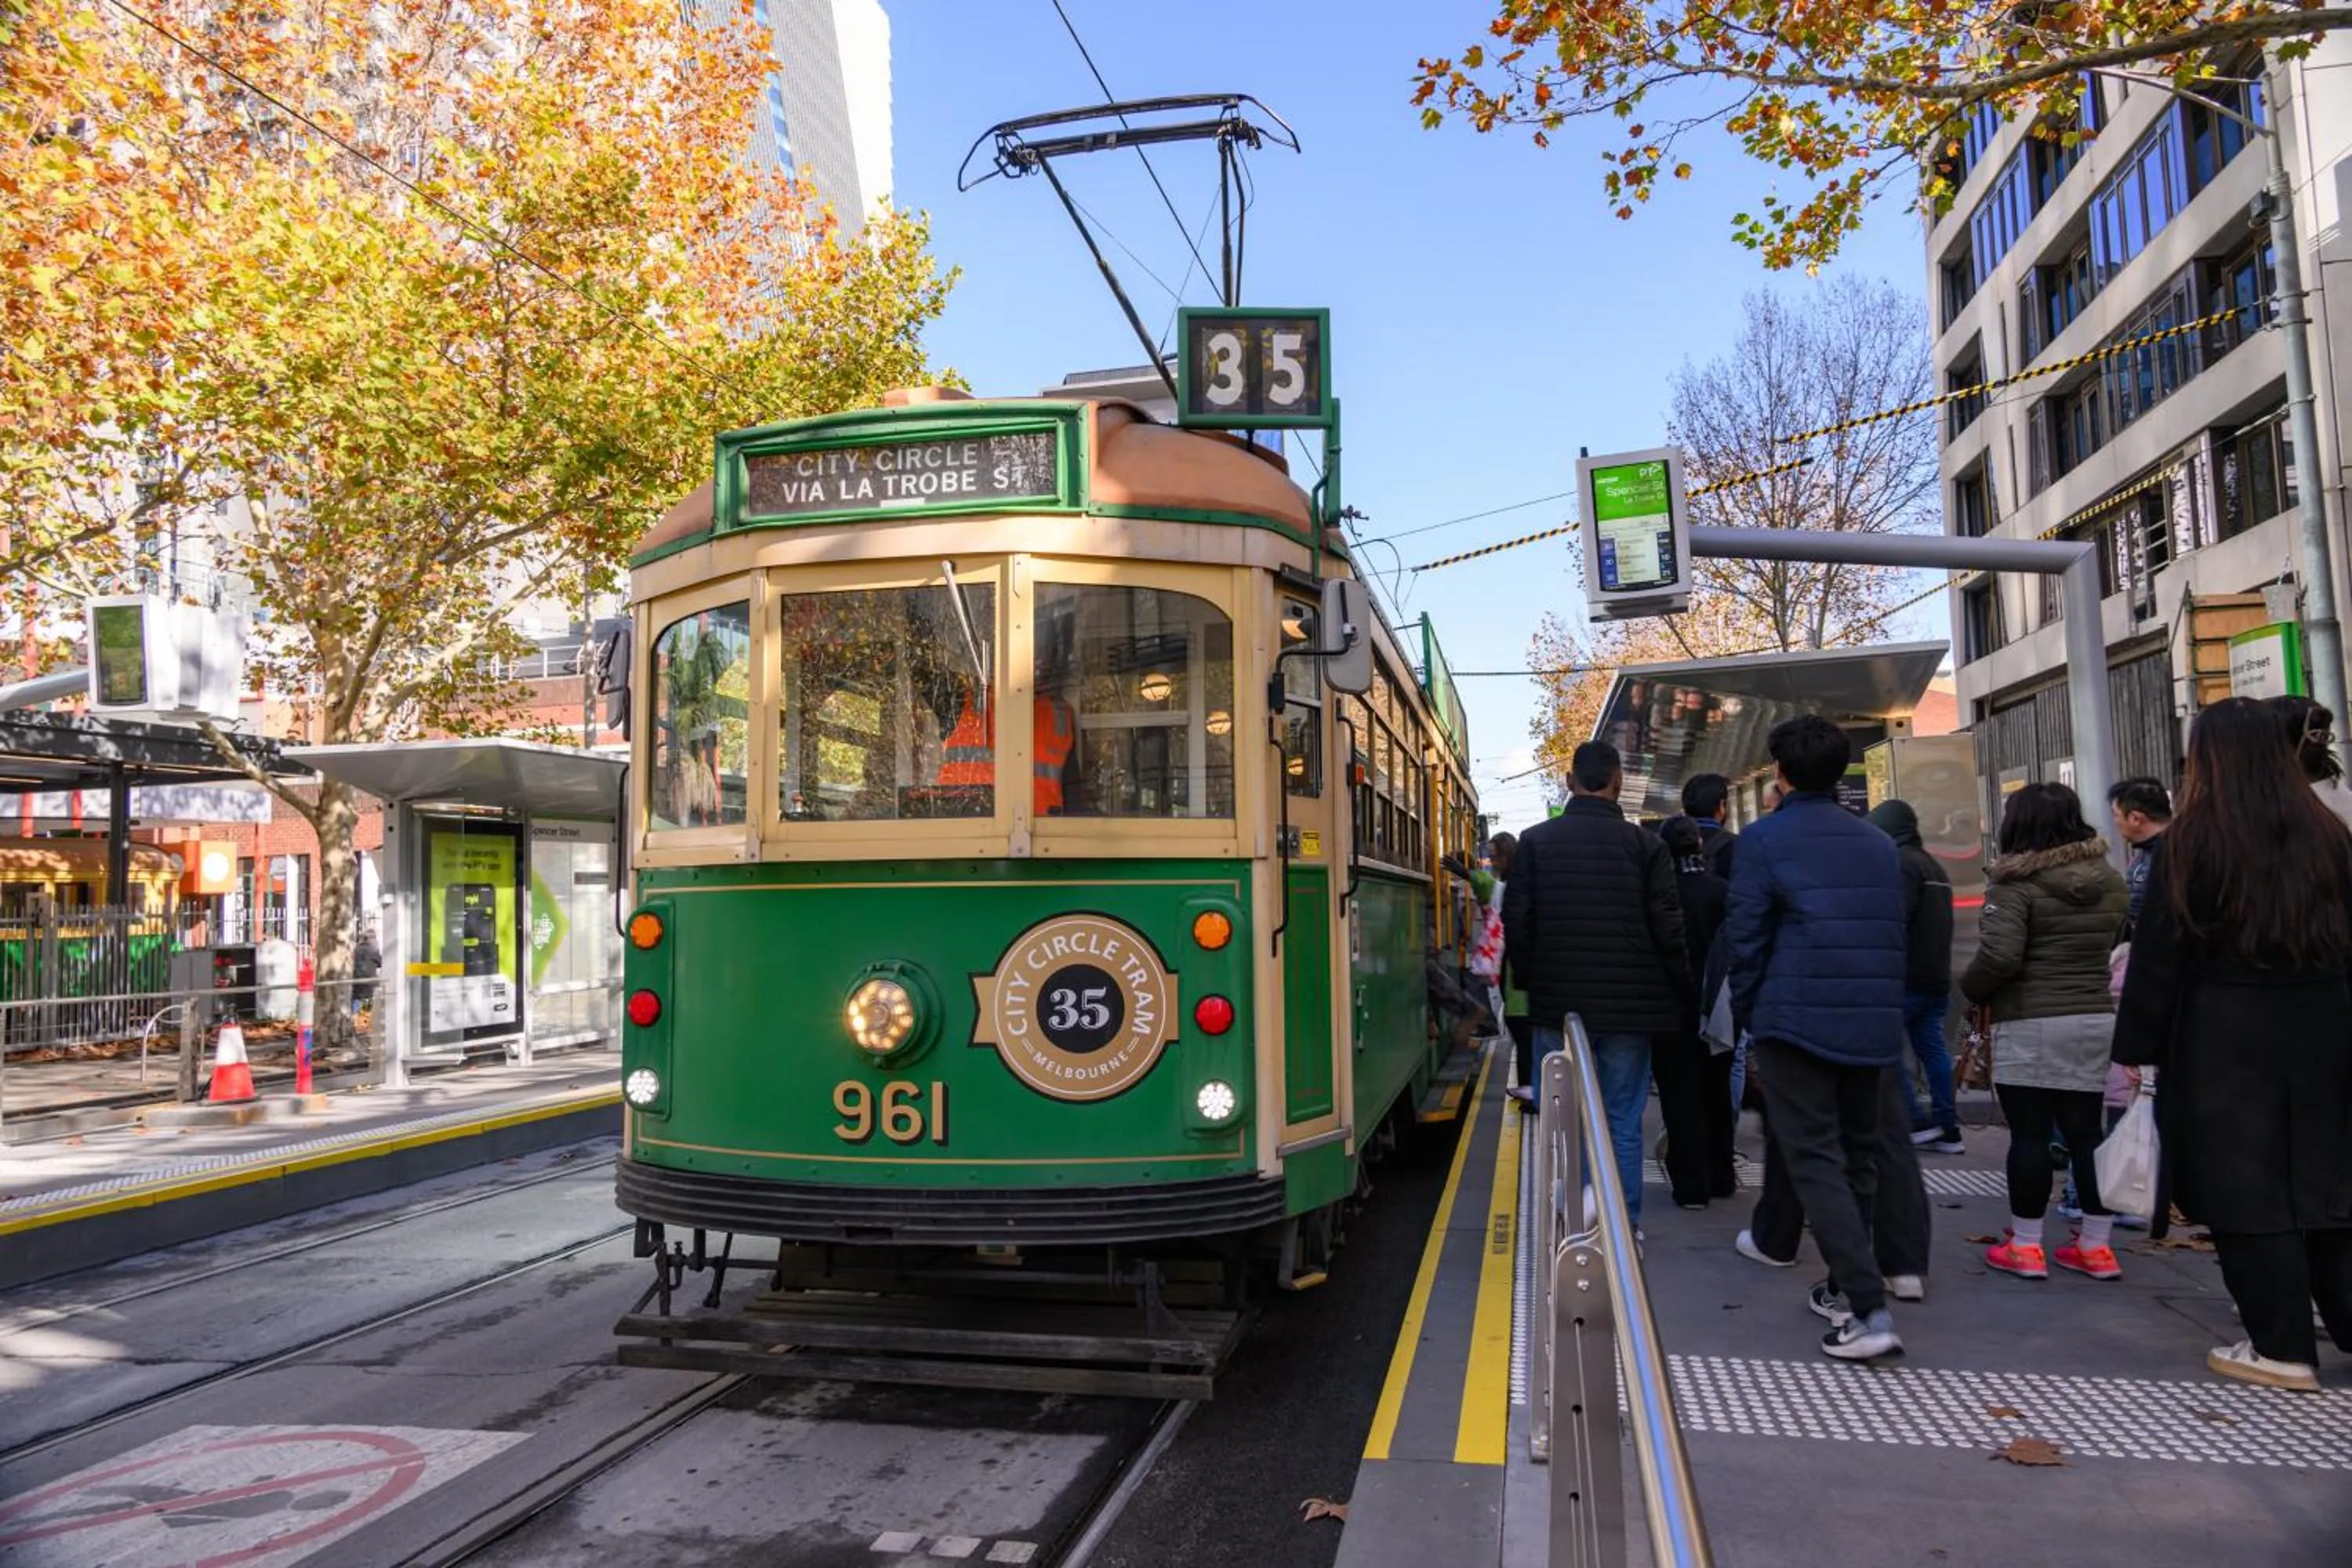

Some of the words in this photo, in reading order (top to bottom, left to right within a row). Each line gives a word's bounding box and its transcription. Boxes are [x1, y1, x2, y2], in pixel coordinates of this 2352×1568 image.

[1206, 332, 1305, 405] 35
[797, 452, 860, 477] CITY
[876, 443, 978, 470] CIRCLE
[782, 477, 826, 503] VIA
[840, 477, 874, 500] LA
[883, 469, 978, 497] TROBE
[1006, 973, 1030, 1036] CITY
[1028, 931, 1121, 971] CIRCLE
[1119, 953, 1155, 1036] TRAM
[1047, 985, 1111, 1030] 35
[1033, 1049, 1129, 1080] MELBOURNE
[833, 1080, 947, 1145] 961
